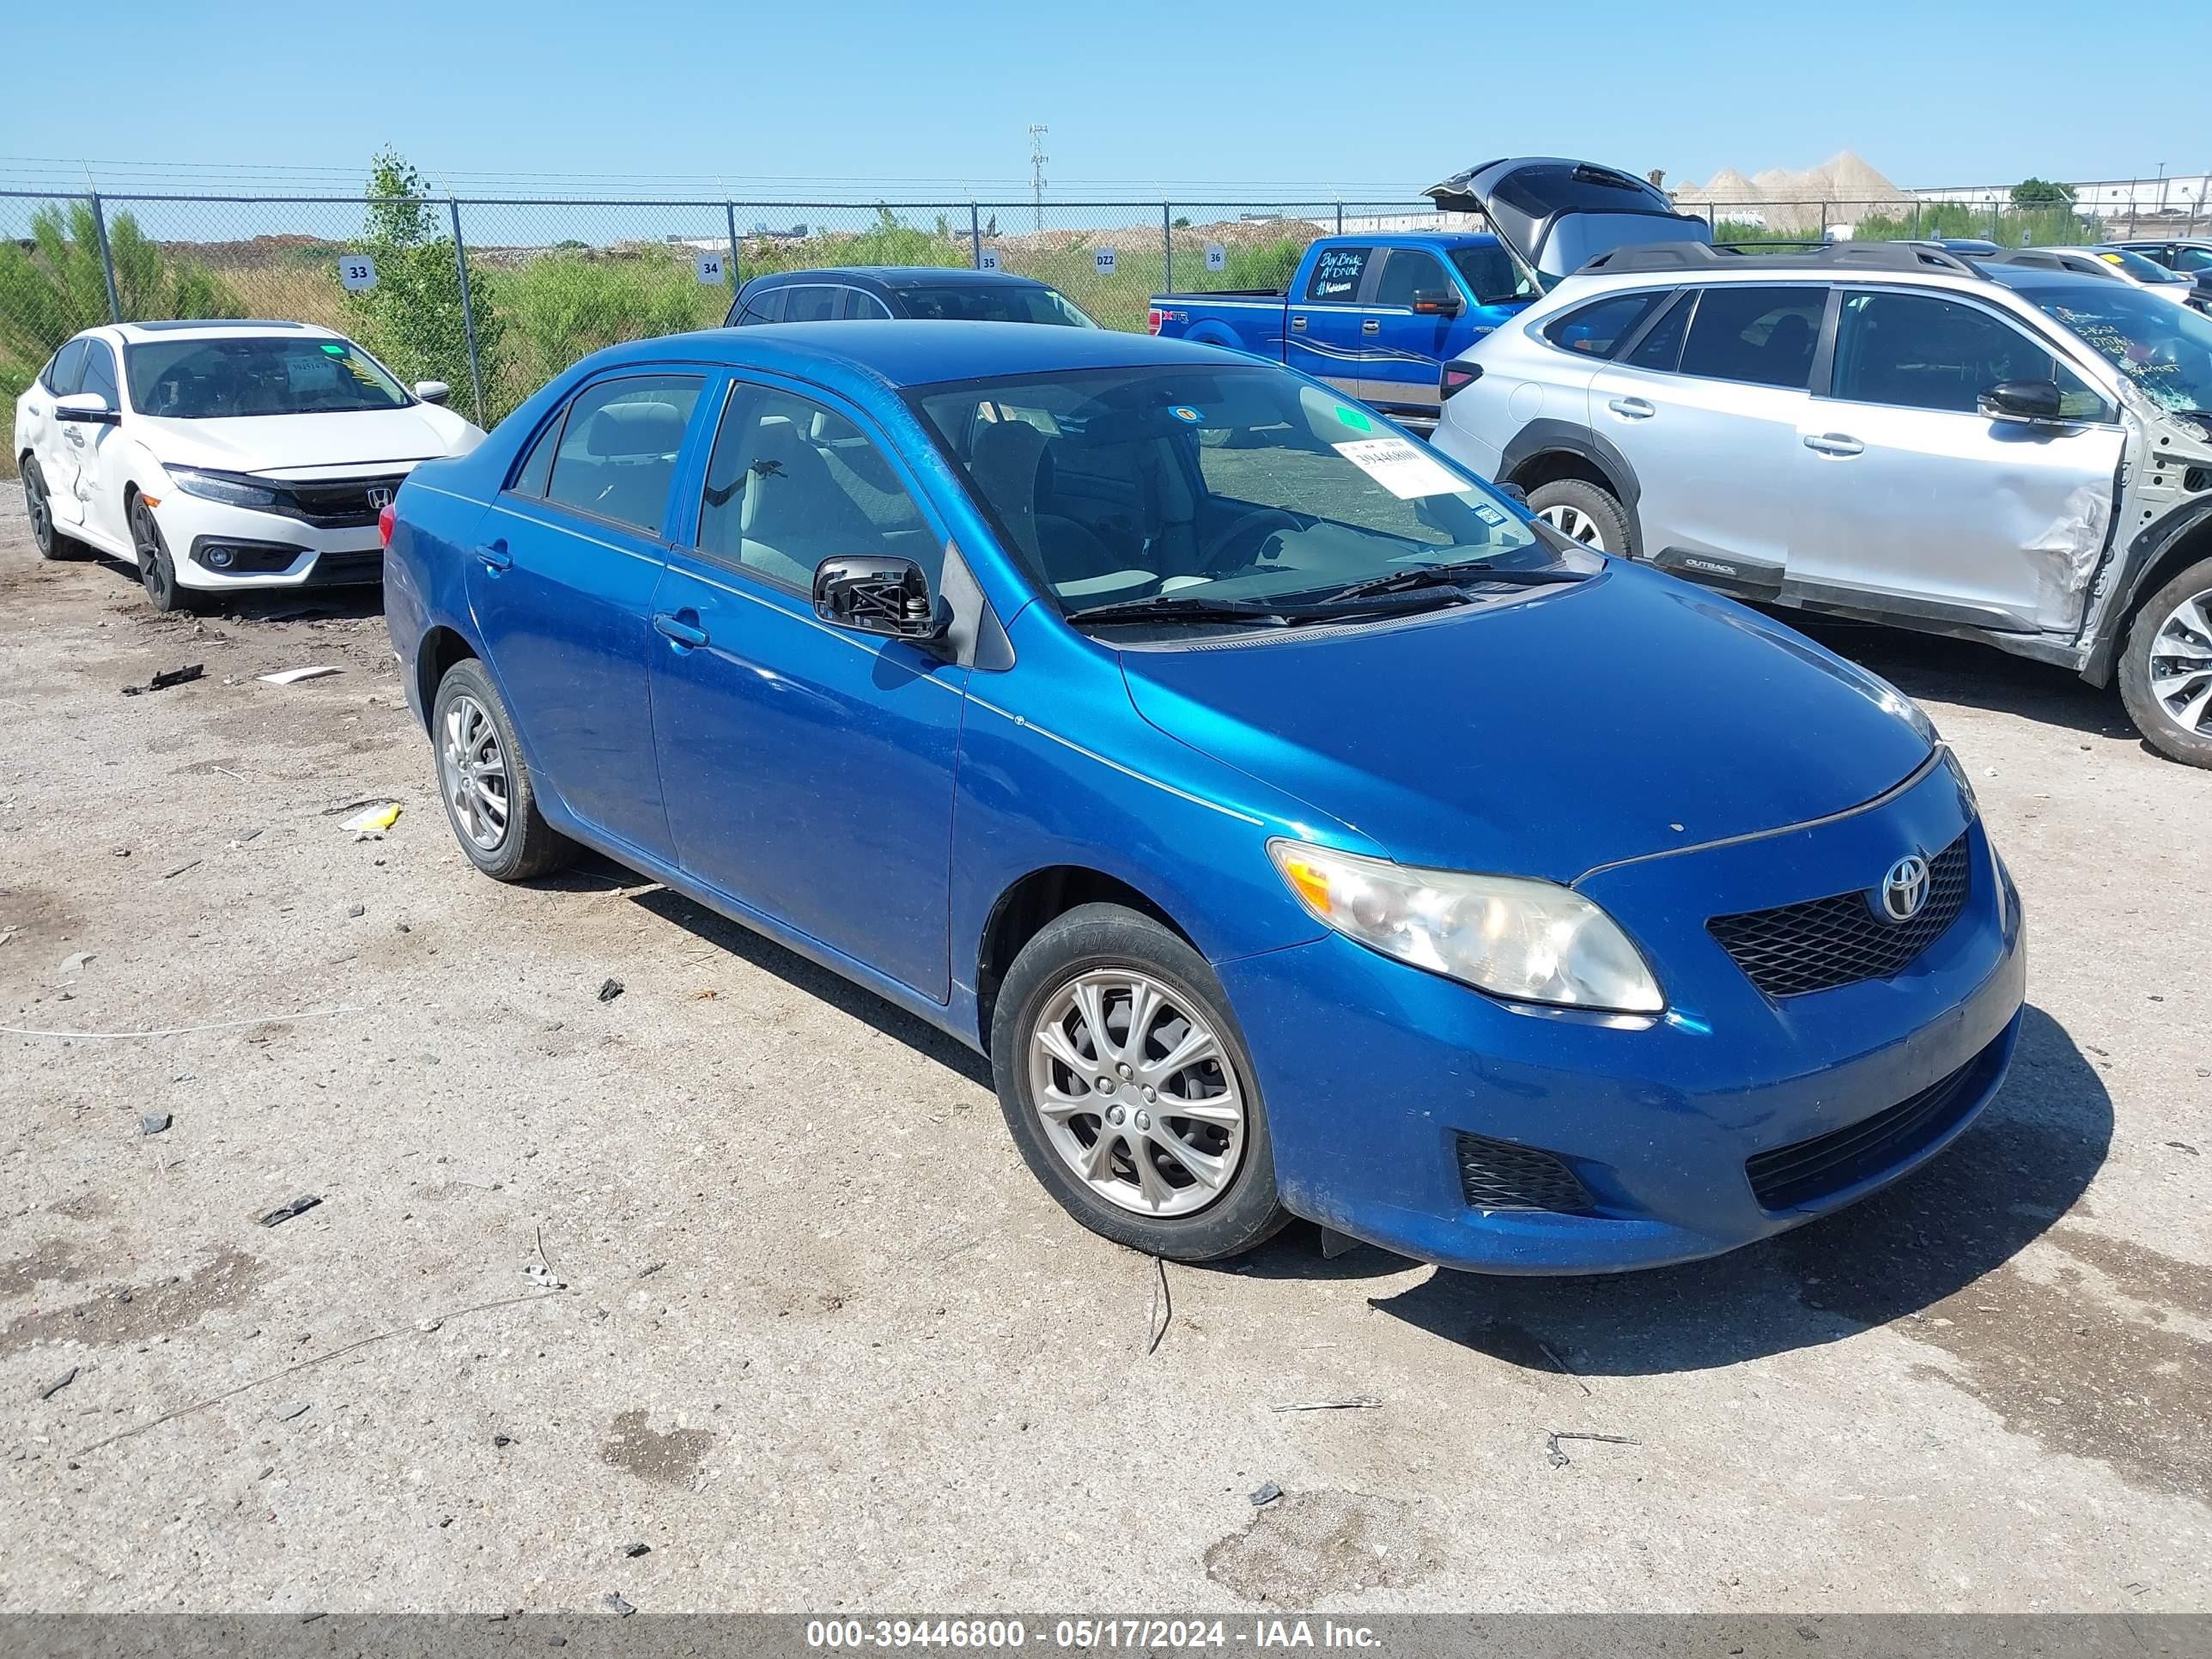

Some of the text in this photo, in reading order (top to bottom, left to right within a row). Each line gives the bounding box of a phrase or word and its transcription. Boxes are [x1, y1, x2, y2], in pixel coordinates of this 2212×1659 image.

[983, 258, 995, 268] 35
[1097, 255, 1114, 265] DZ2
[1211, 252, 1220, 262] 36
[1337, 252, 1363, 265] Bride
[349, 266, 368, 278] 33
[704, 263, 718, 273] 34
[1321, 264, 1359, 279] A Drink
[1356, 450, 1419, 465] 39446800
[1686, 559, 1736, 574] OUTBACK
